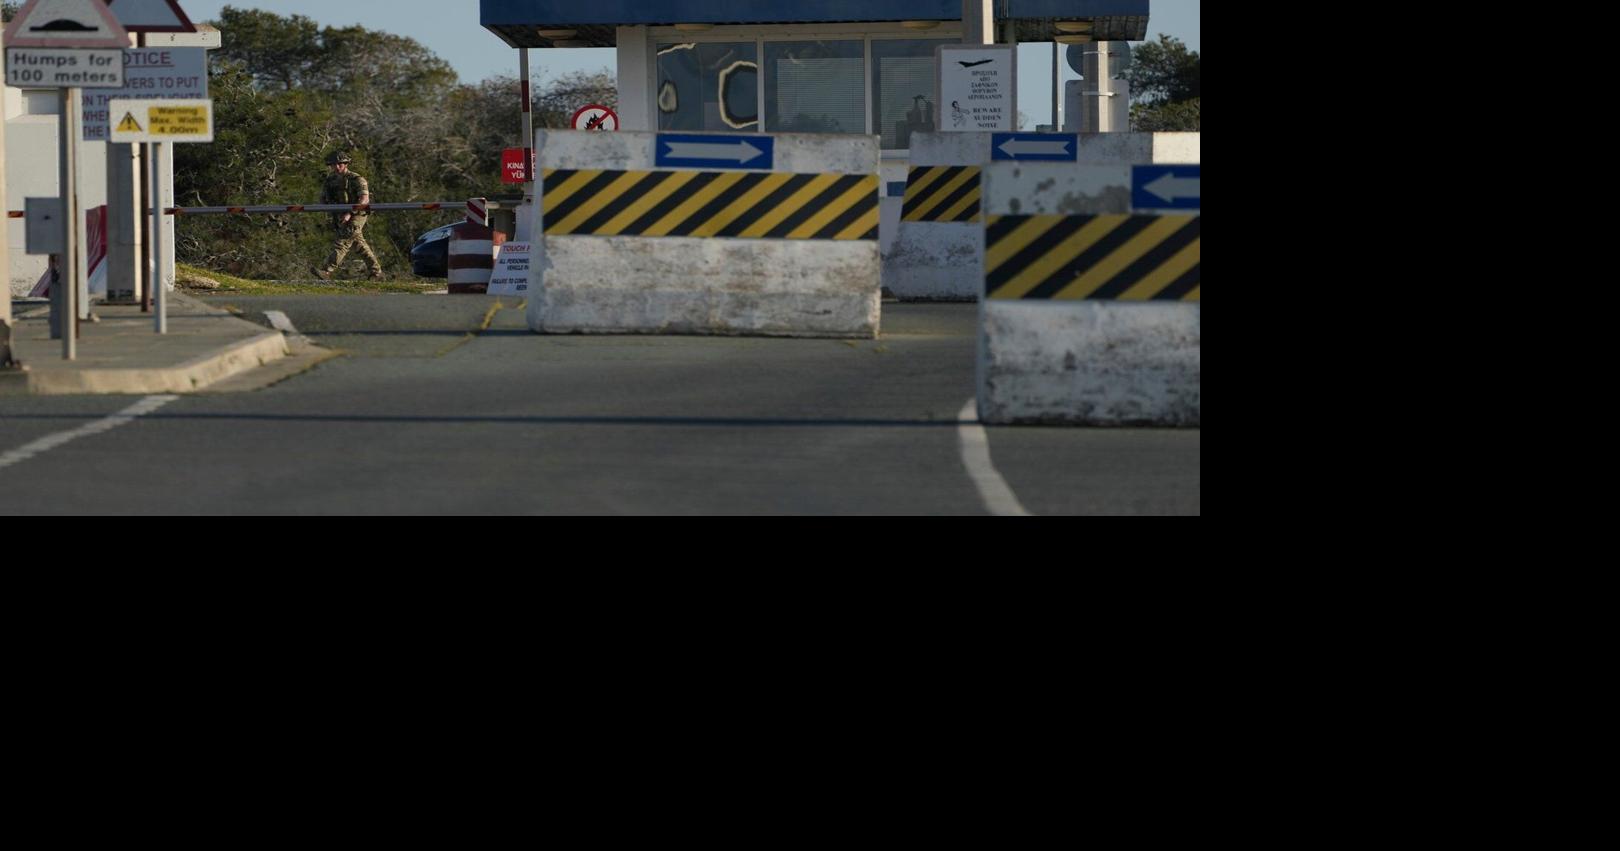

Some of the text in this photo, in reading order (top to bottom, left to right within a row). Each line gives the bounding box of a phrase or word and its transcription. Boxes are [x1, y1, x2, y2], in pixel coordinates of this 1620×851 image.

[14, 53, 114, 68] Humps for
[123, 51, 171, 64] OTICE
[11, 69, 117, 82] 100 meters
[158, 77, 173, 88] TO
[176, 76, 199, 88] PUT
[158, 106, 198, 116] Warning
[178, 116, 205, 124] Width
[83, 126, 103, 137] THE
[158, 126, 198, 134] 4.00m
